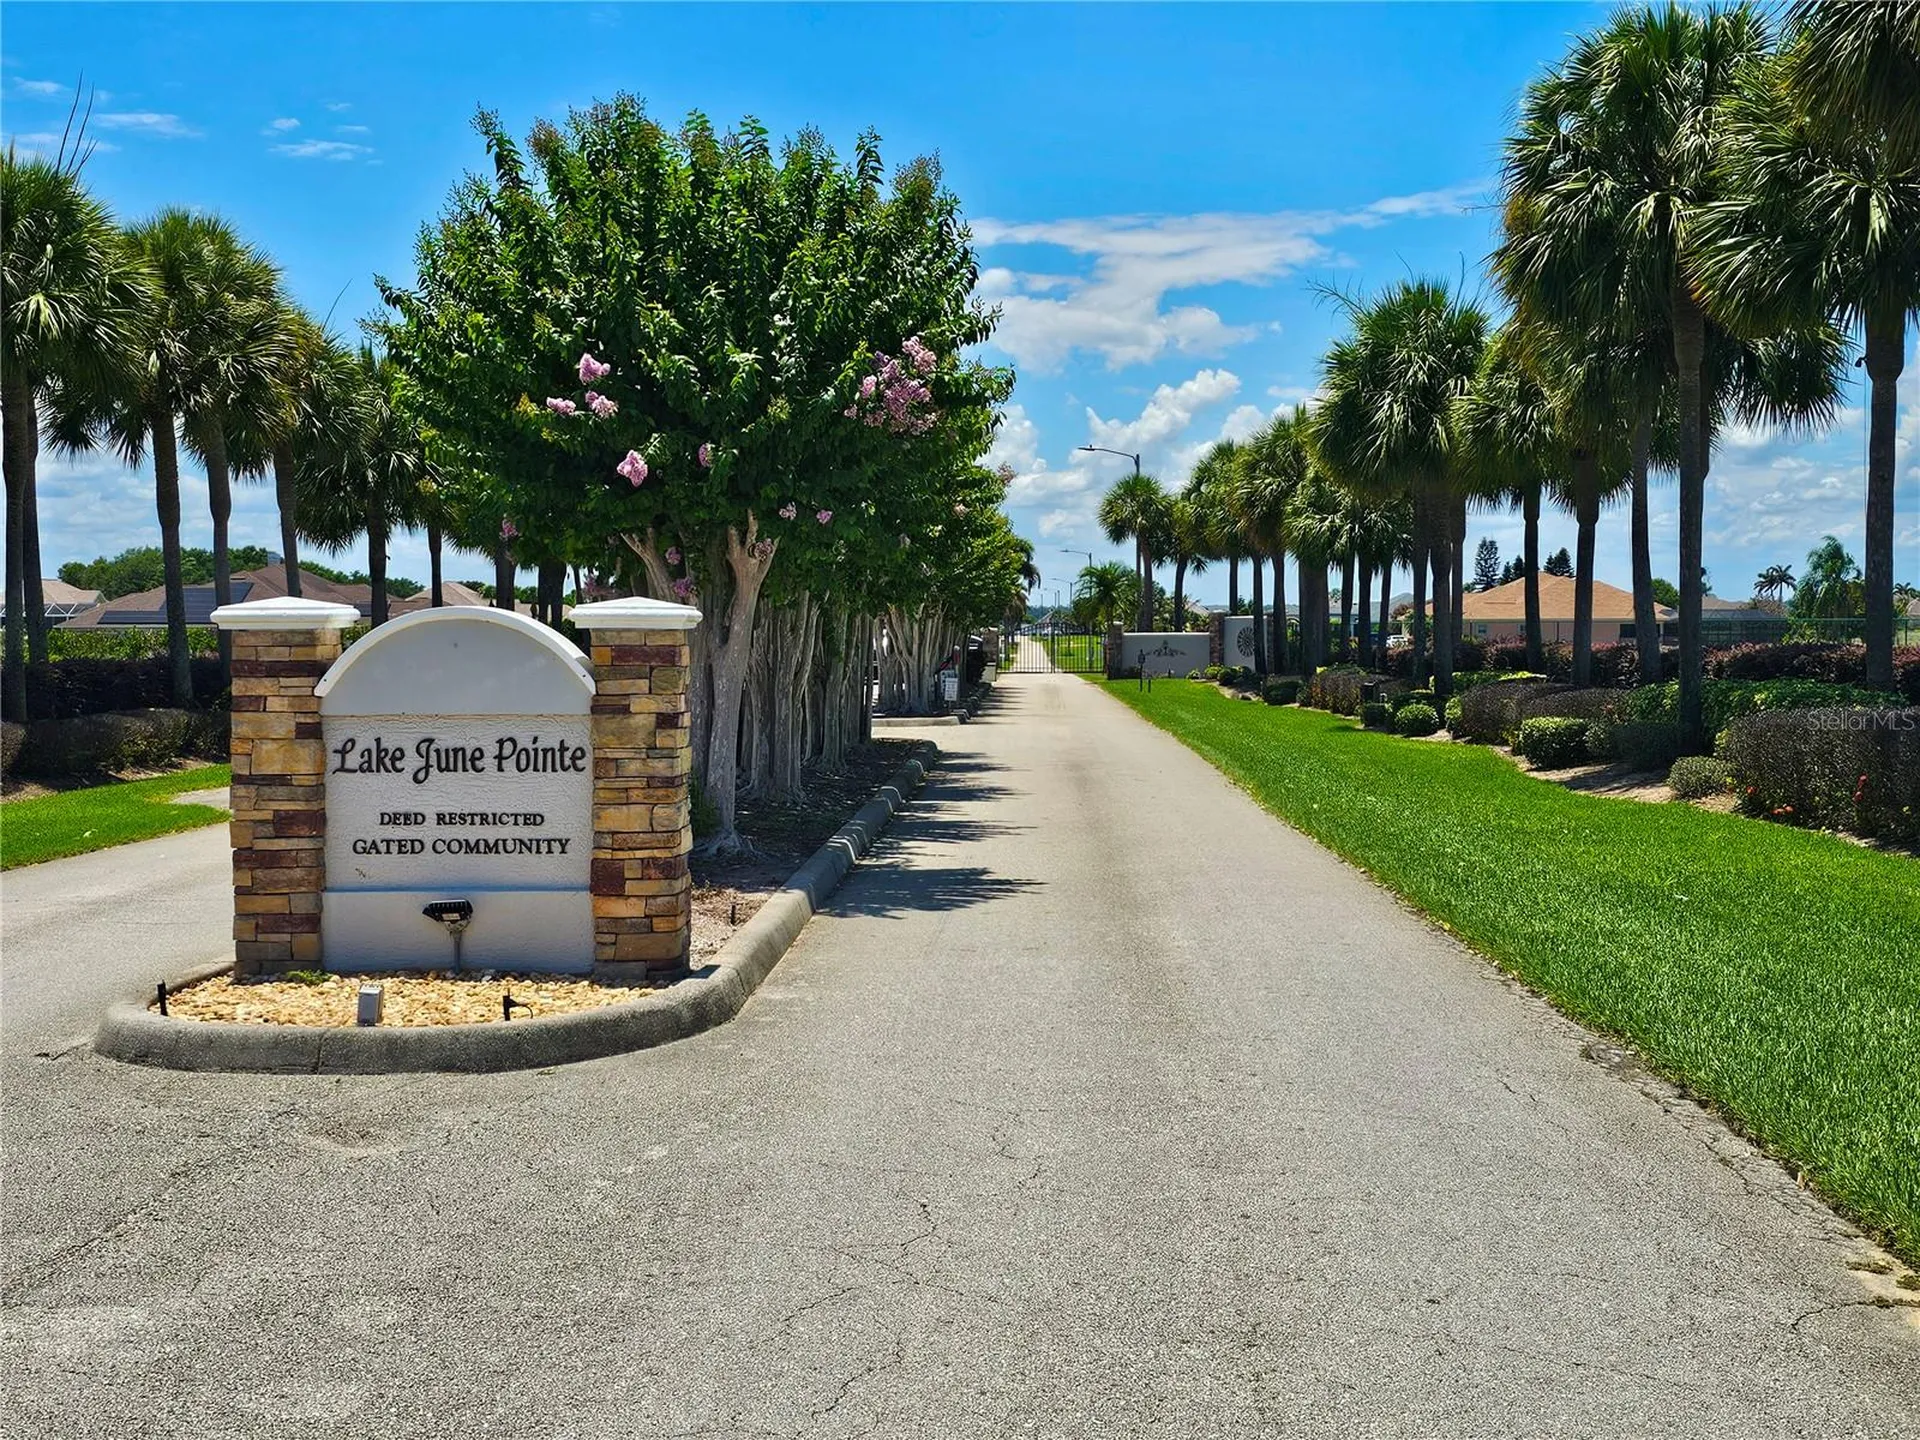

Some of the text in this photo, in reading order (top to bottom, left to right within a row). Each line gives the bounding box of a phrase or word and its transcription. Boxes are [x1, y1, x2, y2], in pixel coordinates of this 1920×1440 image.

[332, 735, 587, 785] Lake June Pointe
[379, 811, 545, 827] DEED RESTRICTED
[352, 837, 571, 855] GATED COMMUNITY
